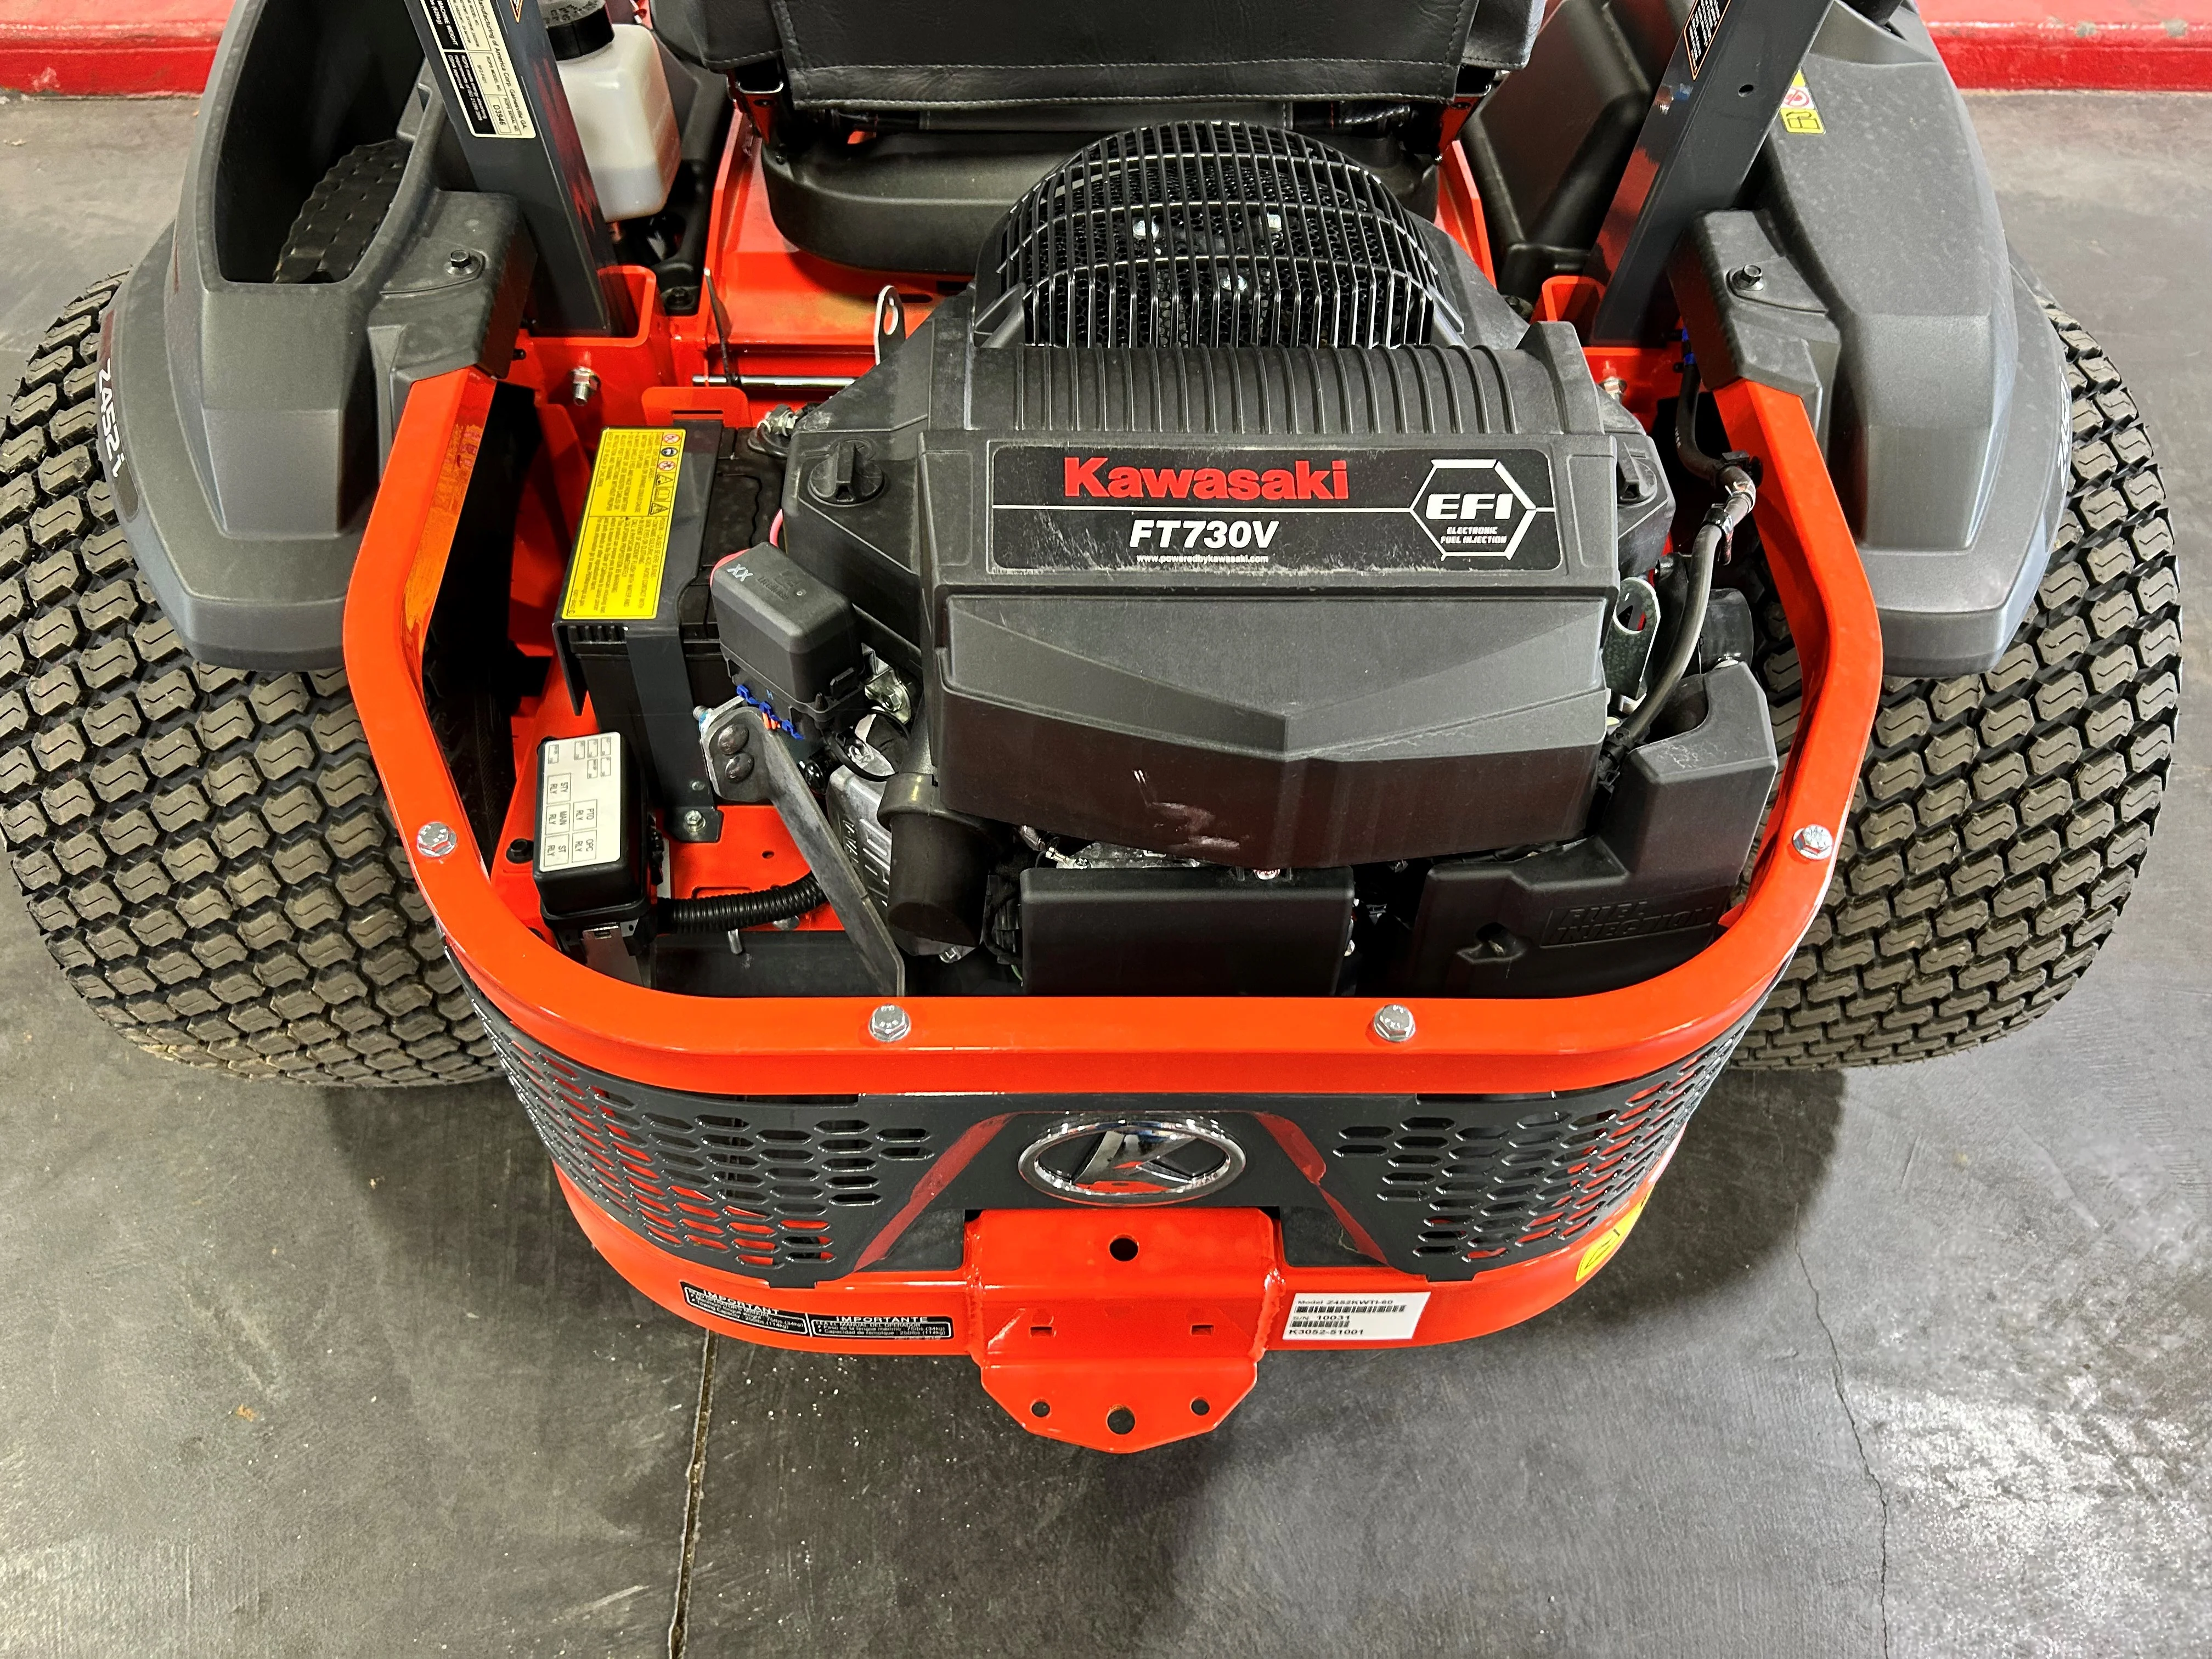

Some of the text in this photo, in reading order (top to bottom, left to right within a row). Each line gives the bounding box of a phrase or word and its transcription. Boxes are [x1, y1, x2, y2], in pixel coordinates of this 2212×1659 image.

[437, 1, 459, 46] MACHINE WEIGHT
[479, 0, 495, 39] anufacturing
[492, 40, 499, 49] of
[495, 47, 506, 71] America
[1064, 456, 1349, 500] Kawasaki
[1425, 493, 1513, 520] EFI
[1128, 519, 1279, 549] FT730V
[1440, 535, 1508, 544] FUEL INJECTION
[1136, 554, 1269, 564] www.poweredbykawasaki.com
[549, 814, 557, 825] RLY
[575, 810, 584, 821] RLY
[574, 840, 583, 852] RLY
[1562, 900, 1648, 925] FUEL
[1550, 906, 1714, 944] INJECTION
[703, 1290, 779, 1314] IMPORTANT
